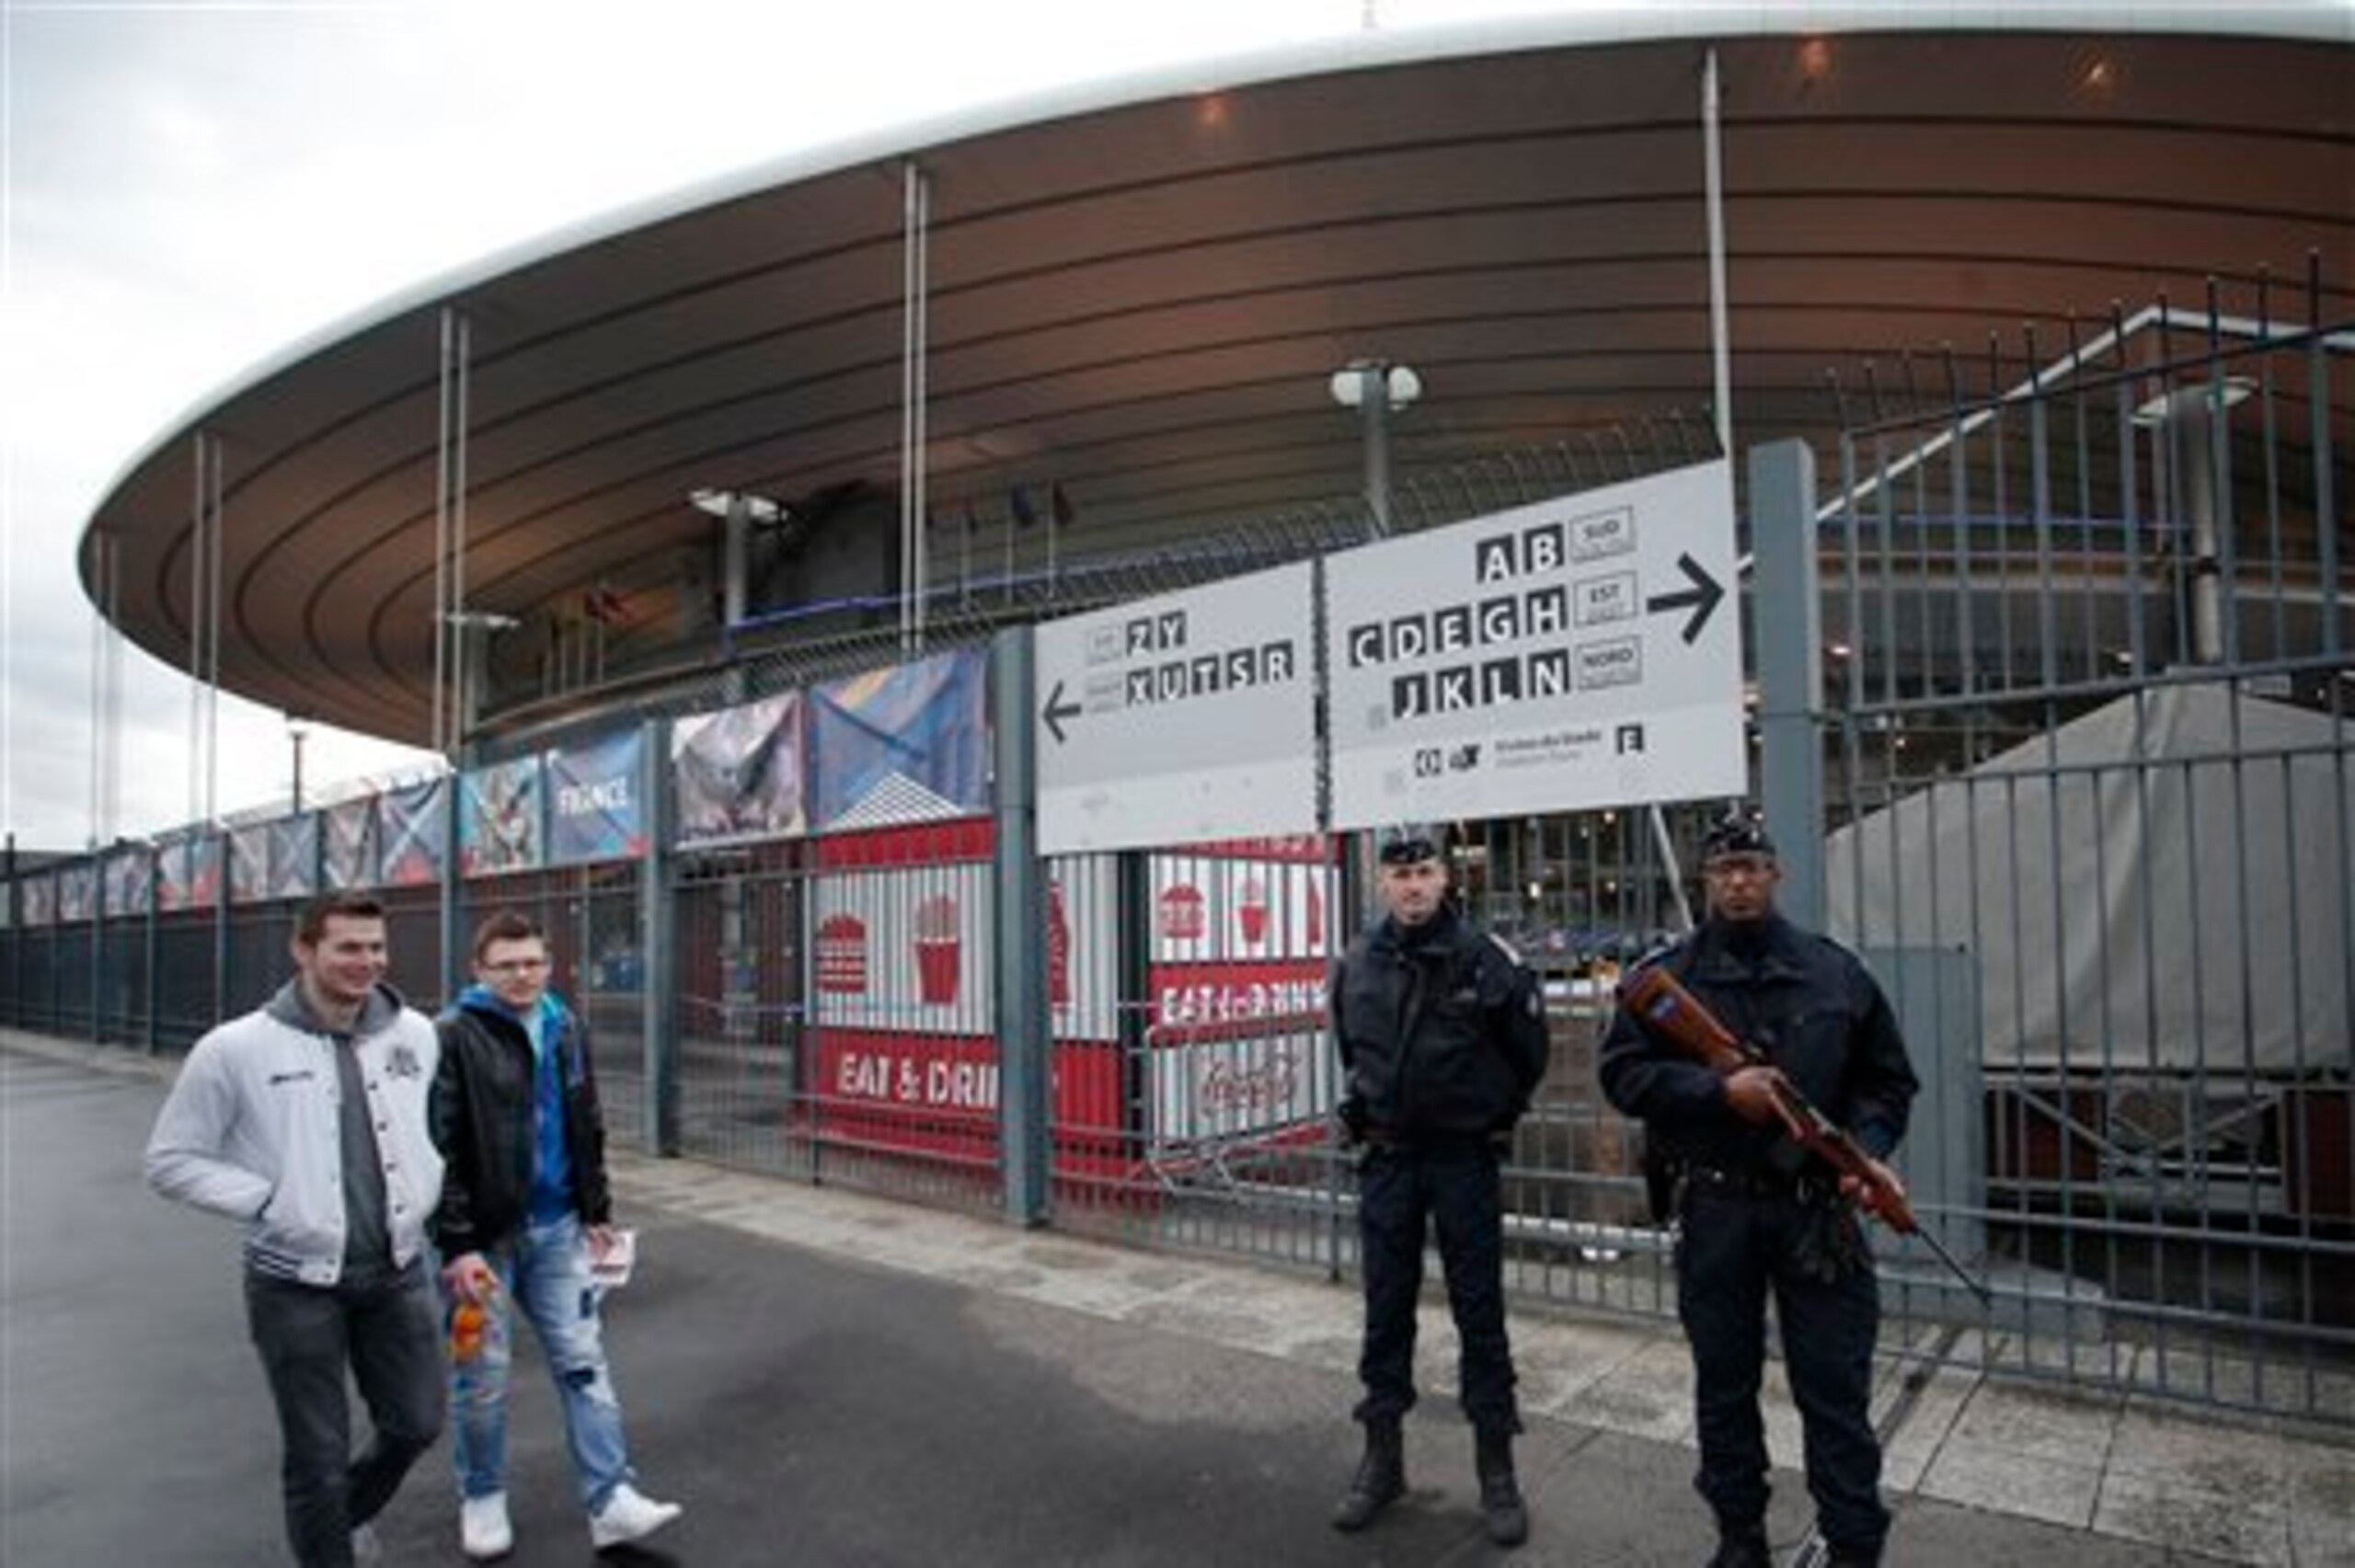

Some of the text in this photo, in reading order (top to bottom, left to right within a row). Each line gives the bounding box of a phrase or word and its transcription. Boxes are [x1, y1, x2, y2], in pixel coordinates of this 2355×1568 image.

[1161, 985, 1215, 1025] EAT
[838, 1052, 1000, 1109] EAT & DRI
